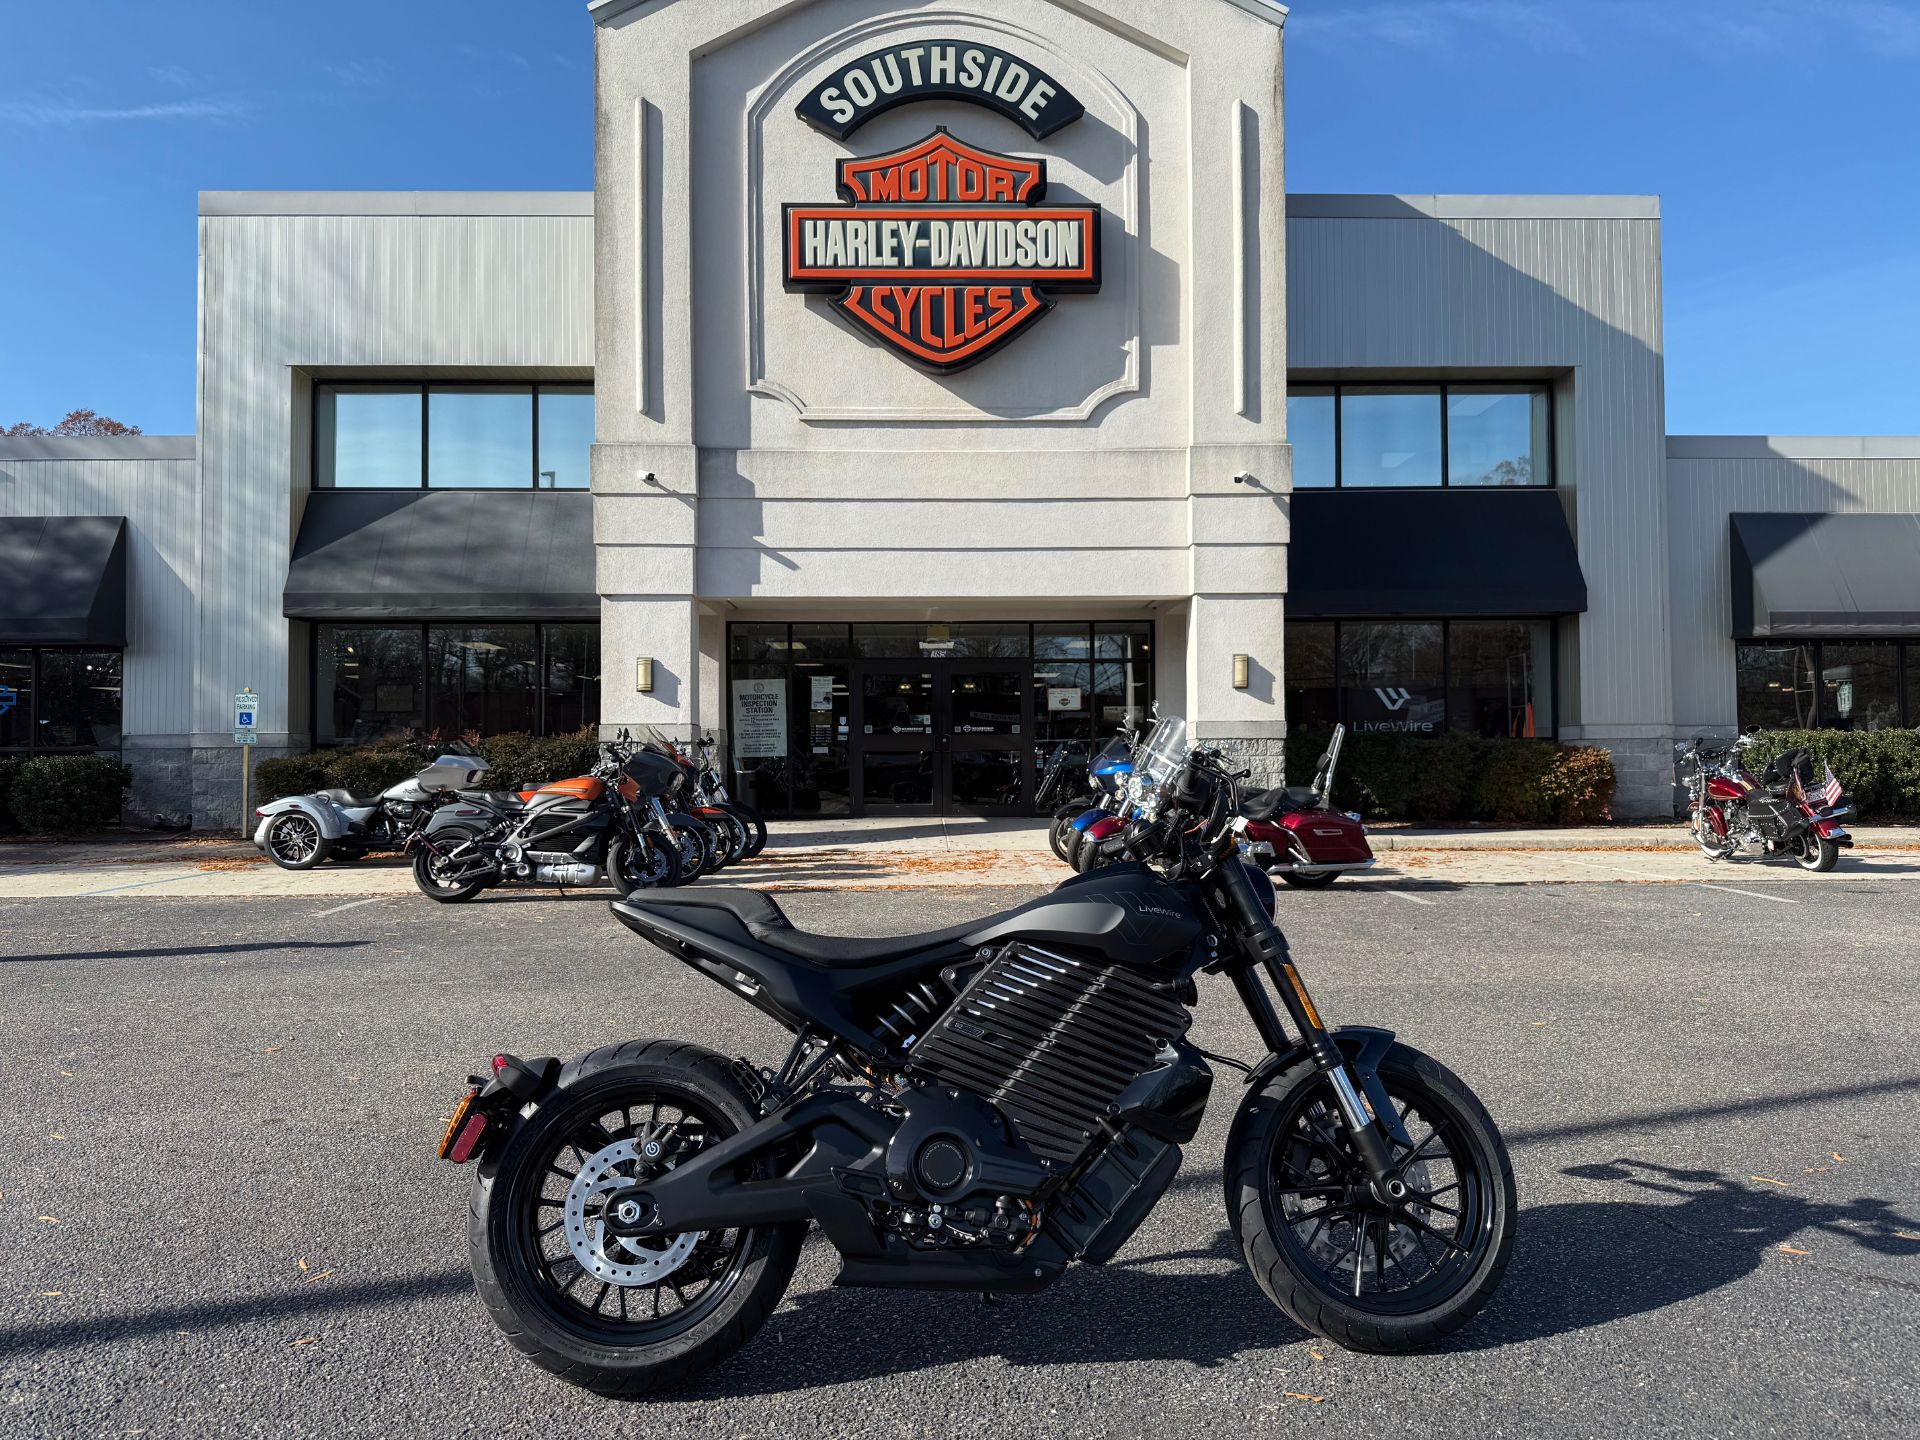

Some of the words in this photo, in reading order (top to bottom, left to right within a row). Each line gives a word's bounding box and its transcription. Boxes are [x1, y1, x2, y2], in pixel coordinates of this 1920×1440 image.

[819, 46, 1057, 124] SOUTHSIDE
[870, 147, 1015, 201] MOTOR
[804, 220, 1081, 267] HARLEY-DAVIDSON
[871, 286, 1014, 349] CYCLES
[1353, 720, 1433, 732] LiveWire
[1138, 905, 1181, 918] LiveWire
